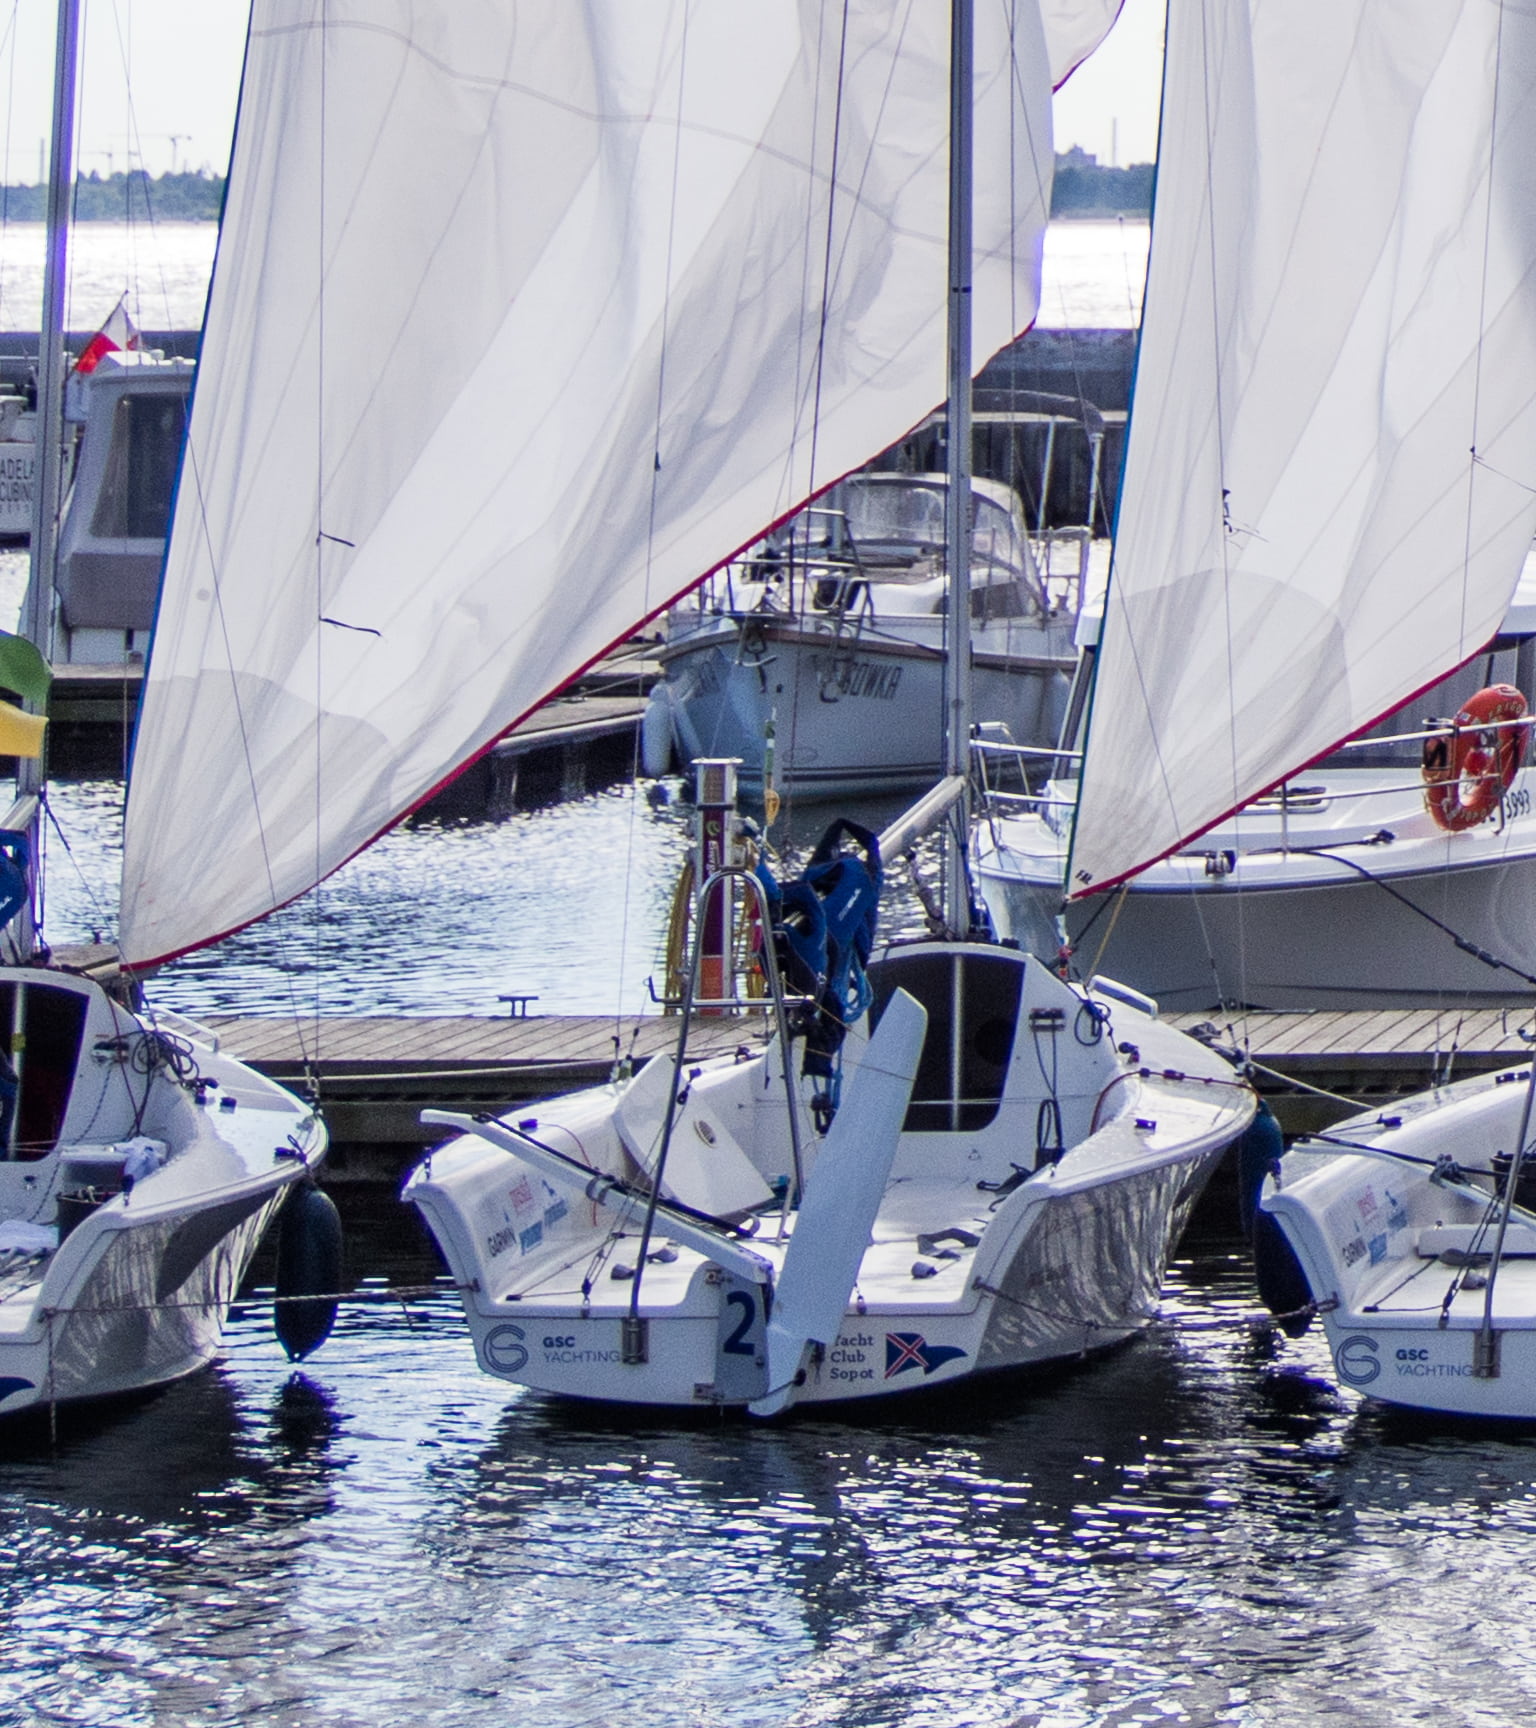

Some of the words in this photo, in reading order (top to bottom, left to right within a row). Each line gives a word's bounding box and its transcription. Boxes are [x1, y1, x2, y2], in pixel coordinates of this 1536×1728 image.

[723, 1290, 756, 1355] 2
[543, 1335, 575, 1348] GSC
[543, 1351, 620, 1364] YACHTING
[830, 1350, 866, 1364] Club
[1395, 1348, 1429, 1361] GSC
[830, 1366, 875, 1382] Sopot
[1396, 1363, 1474, 1377] YACHTING
